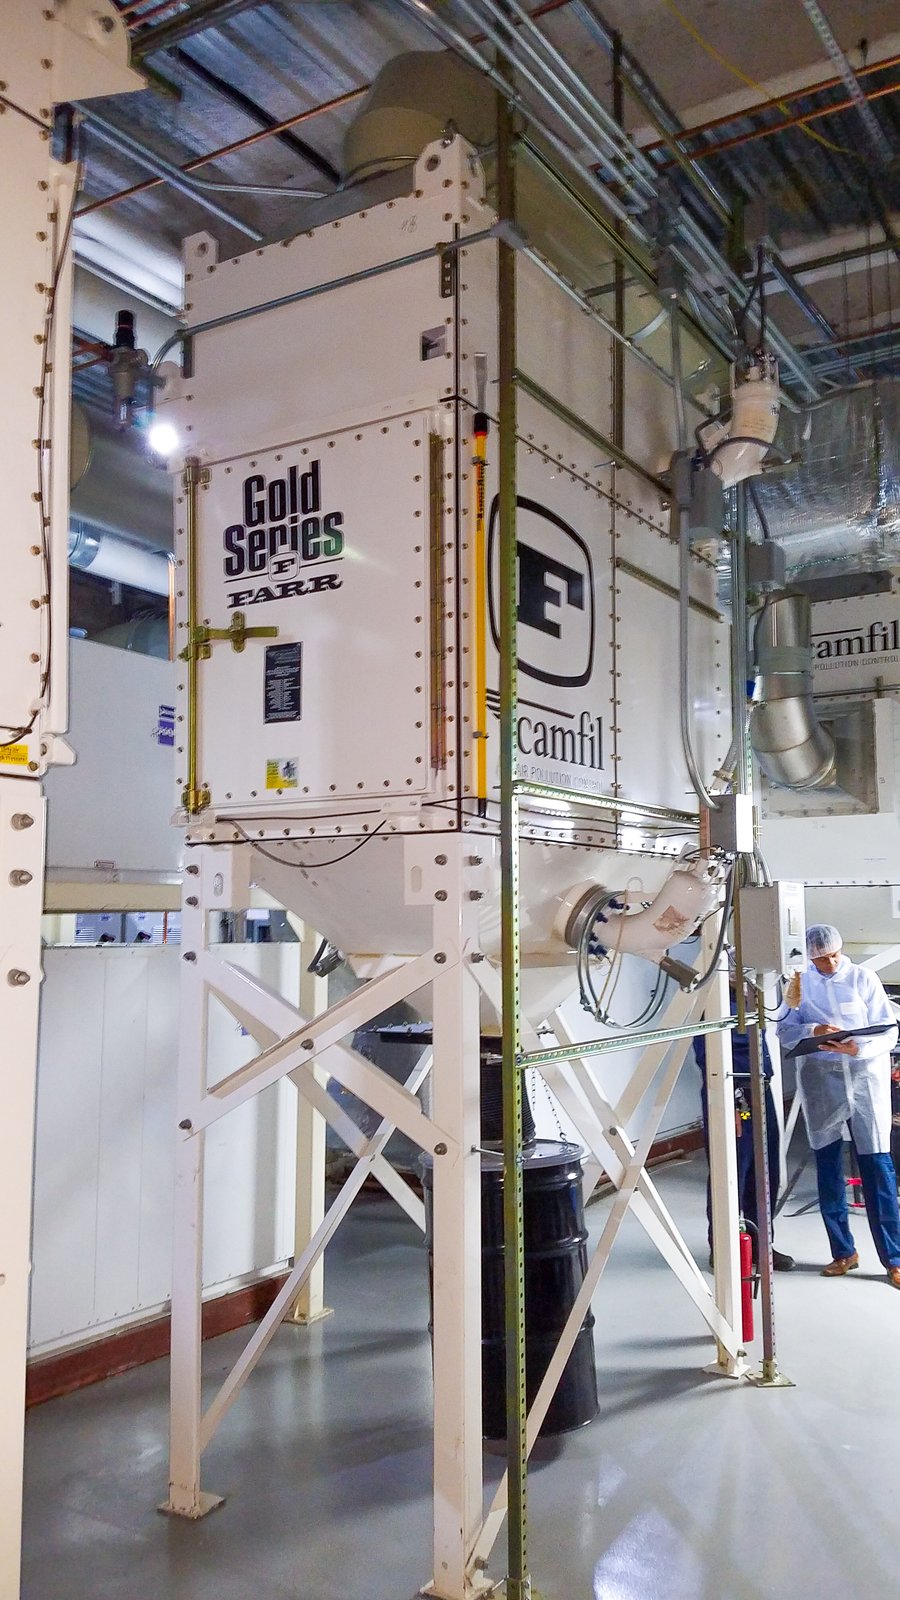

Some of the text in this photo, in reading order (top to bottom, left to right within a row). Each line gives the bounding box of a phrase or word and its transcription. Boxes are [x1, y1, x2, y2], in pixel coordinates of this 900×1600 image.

[243, 459, 321, 528] Gold
[223, 511, 345, 577] Series
[227, 573, 344, 609] FARR
[814, 659, 859, 671] POLLUTION
